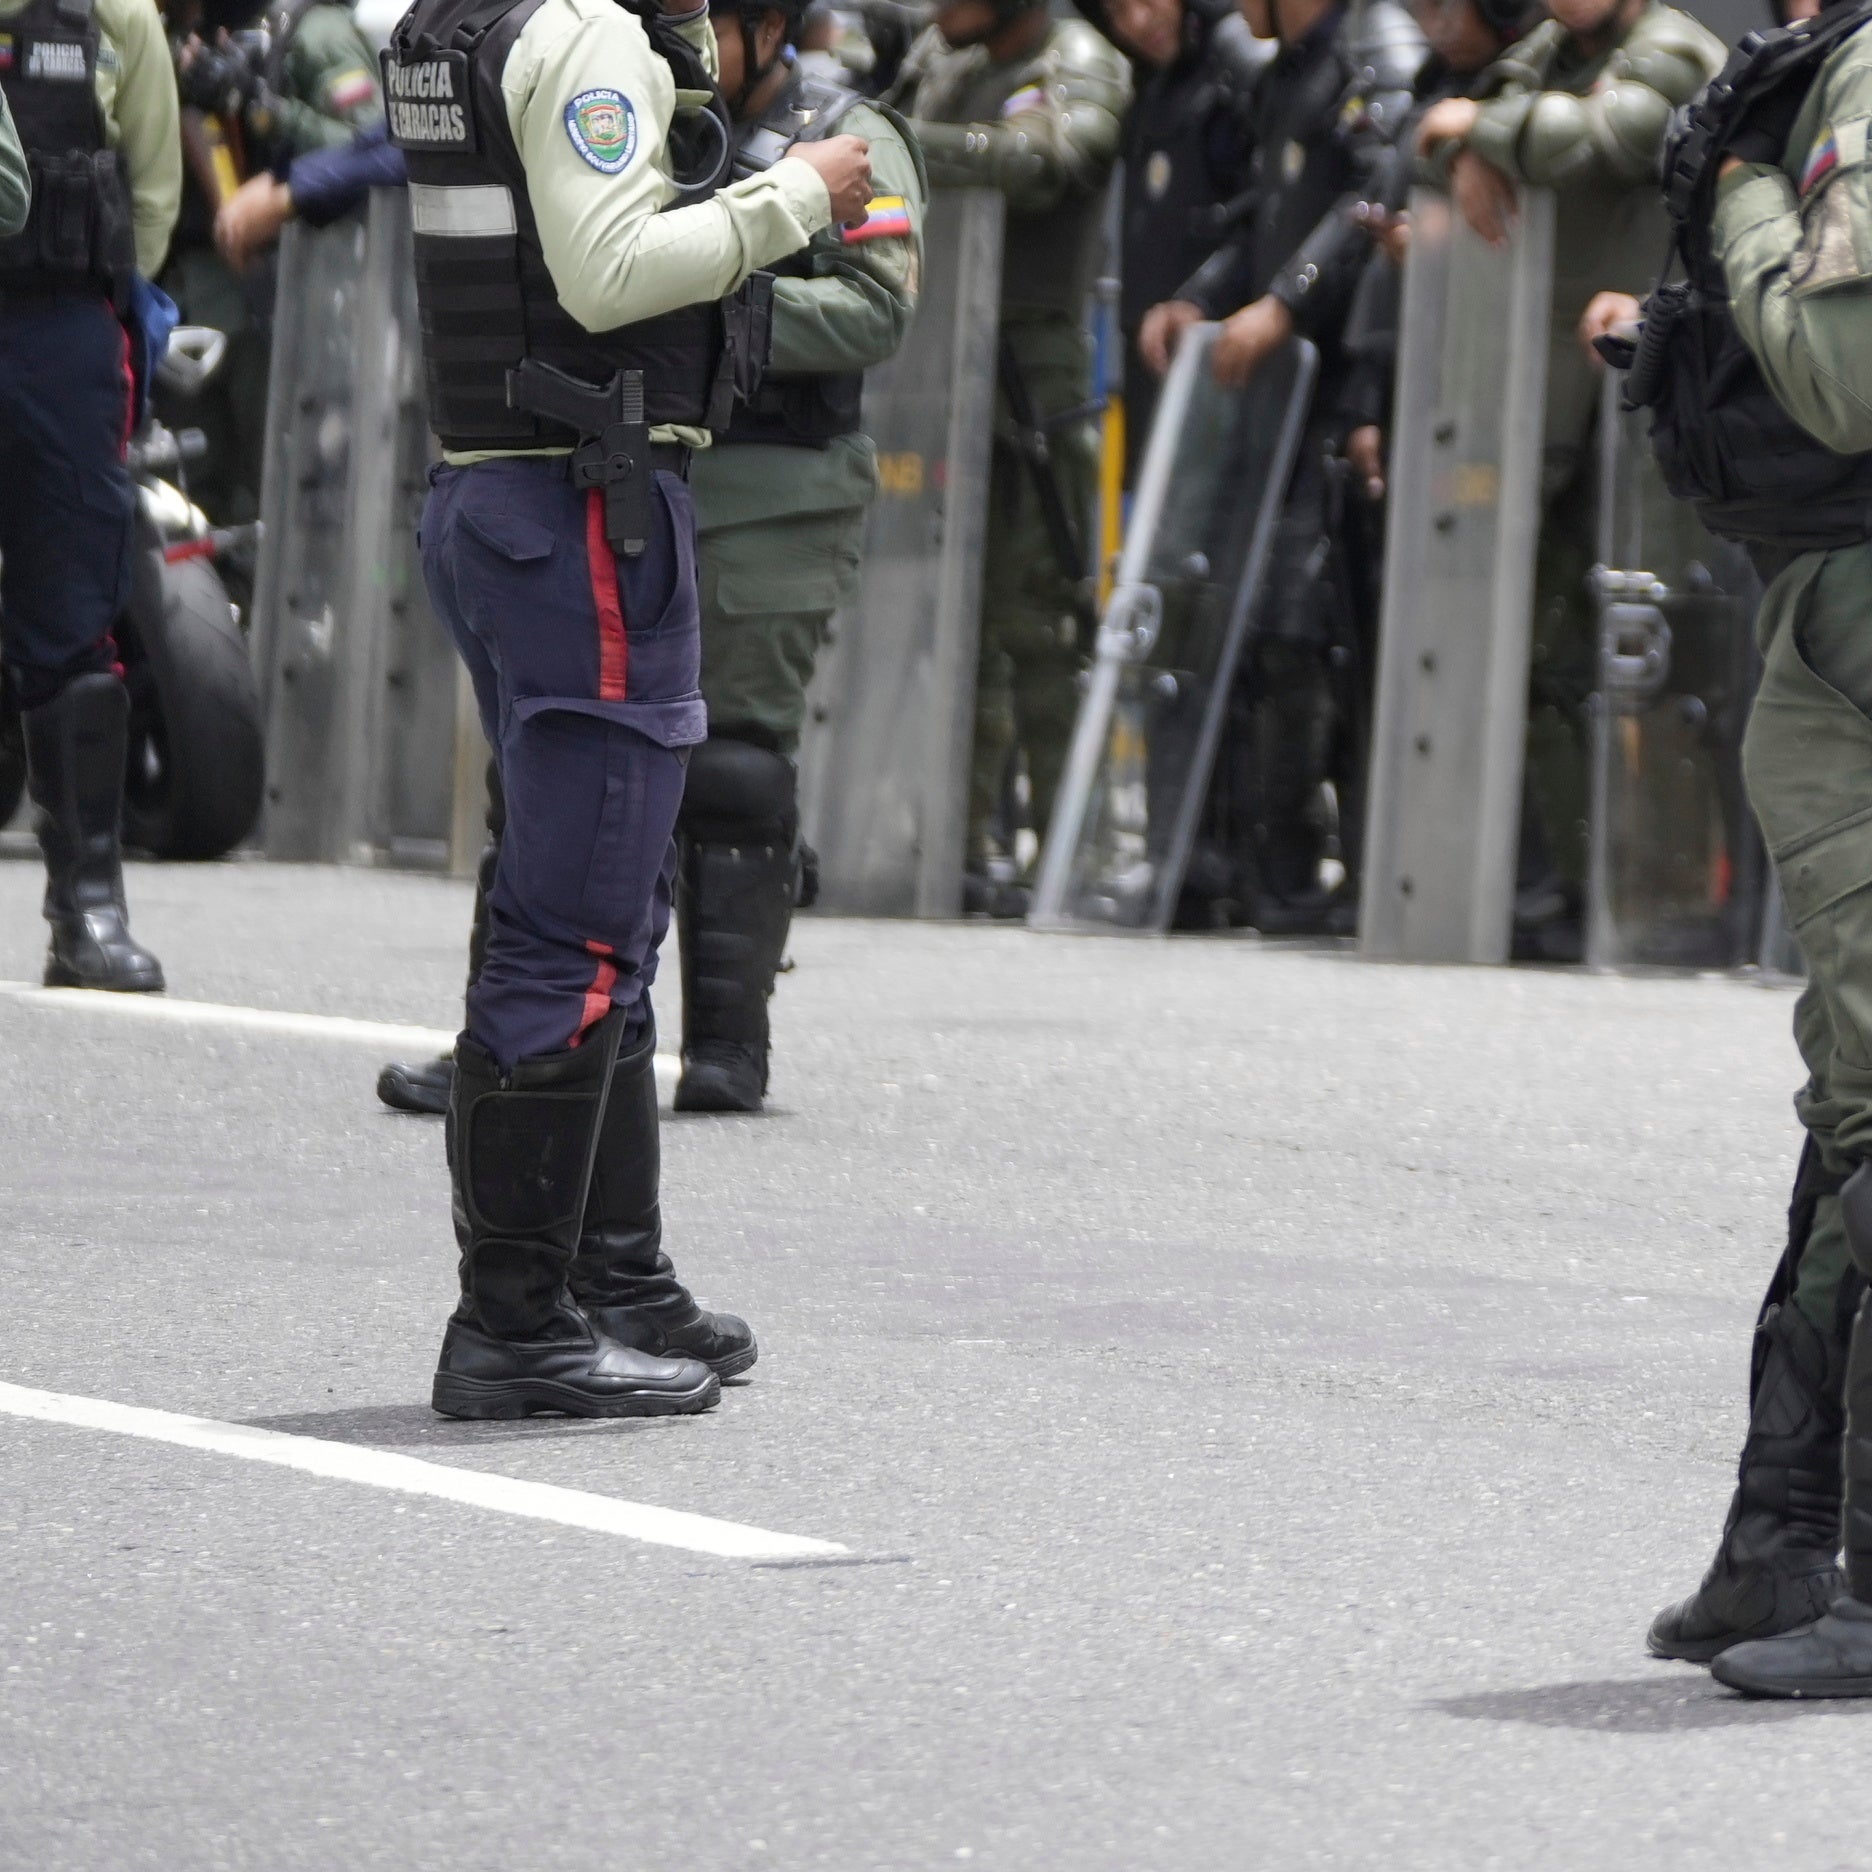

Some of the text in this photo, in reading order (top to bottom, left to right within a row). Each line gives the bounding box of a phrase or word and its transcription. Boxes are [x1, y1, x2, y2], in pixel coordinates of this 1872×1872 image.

[388, 59, 454, 98] POLICIA
[574, 90, 619, 109] POLICIA
[398, 102, 466, 141] CARACAS
